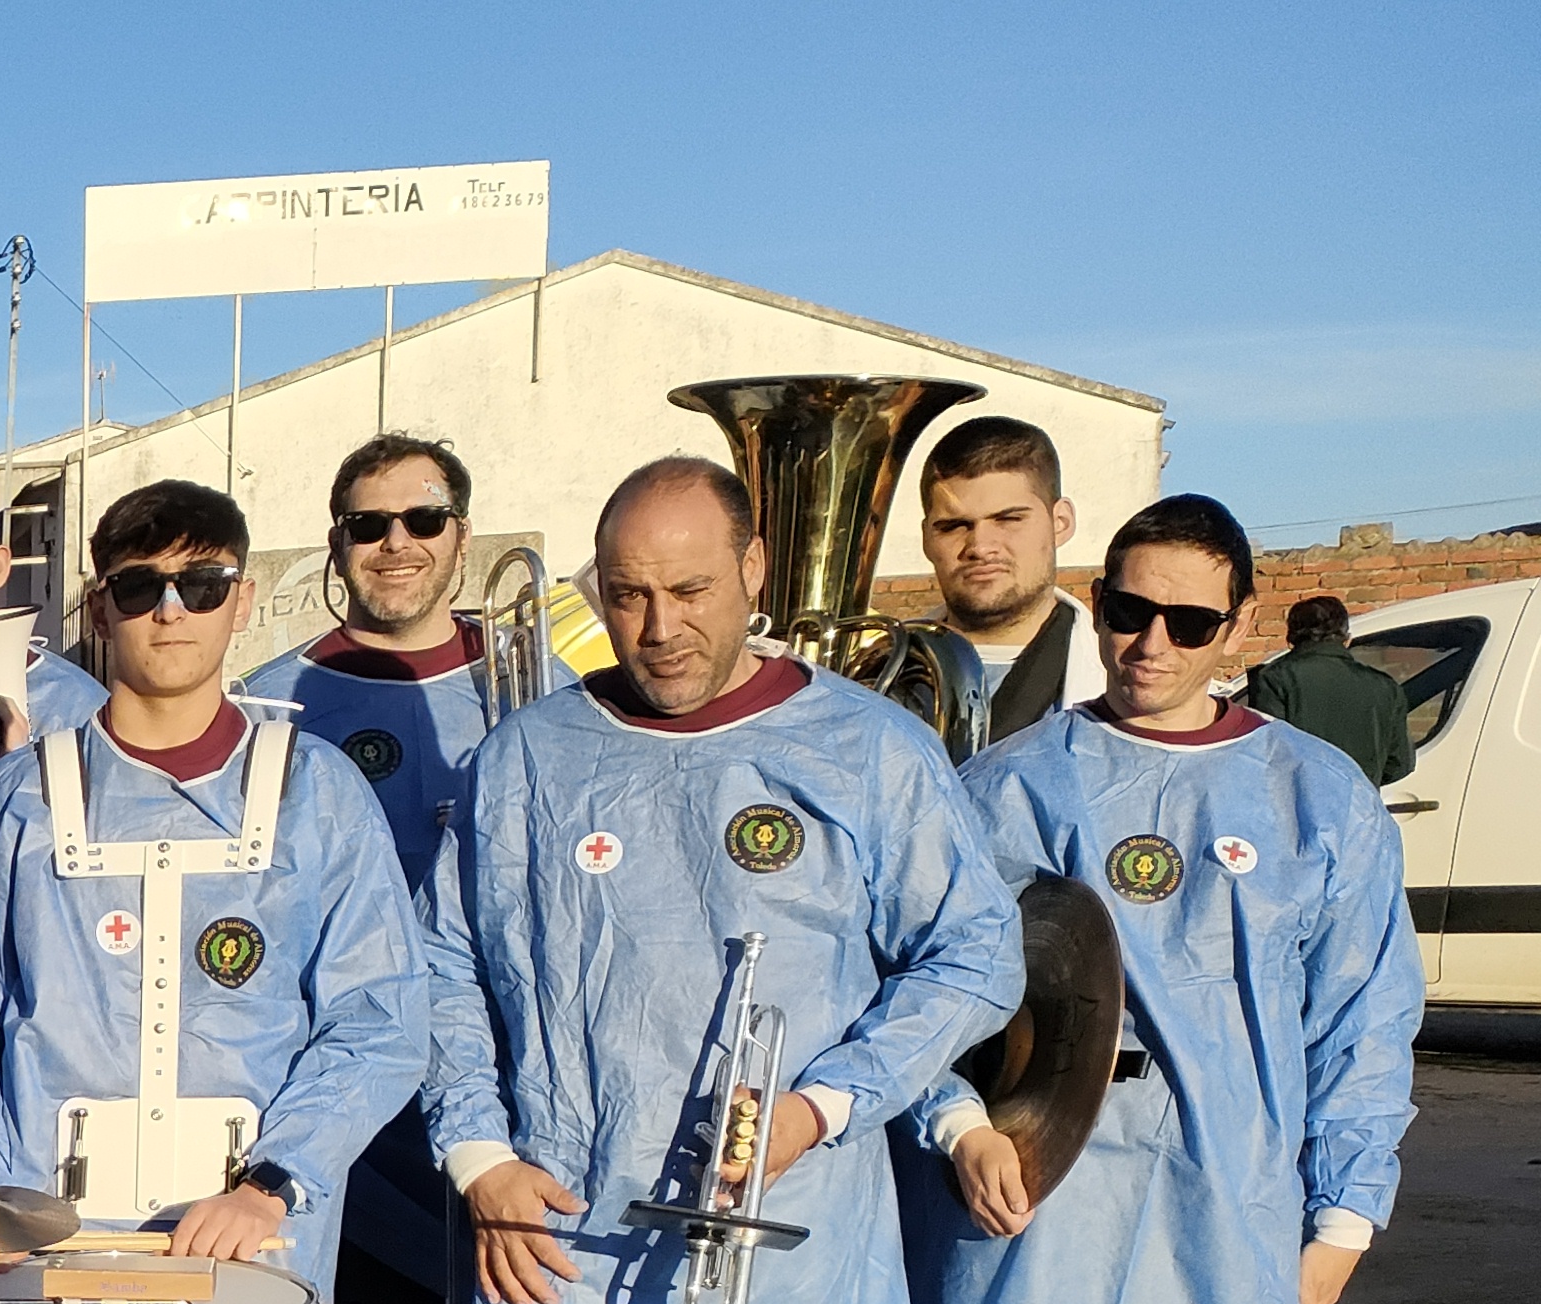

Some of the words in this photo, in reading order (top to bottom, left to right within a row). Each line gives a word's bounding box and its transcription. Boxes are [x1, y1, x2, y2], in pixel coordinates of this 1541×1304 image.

[746, 807, 786, 818] Musical
[784, 815, 795, 826] de
[1128, 837, 1166, 849] Musical
[1164, 846, 1175, 857] de
[749, 860, 778, 871] Toledo
[216, 920, 254, 933] Musical
[250, 931, 260, 942] de
